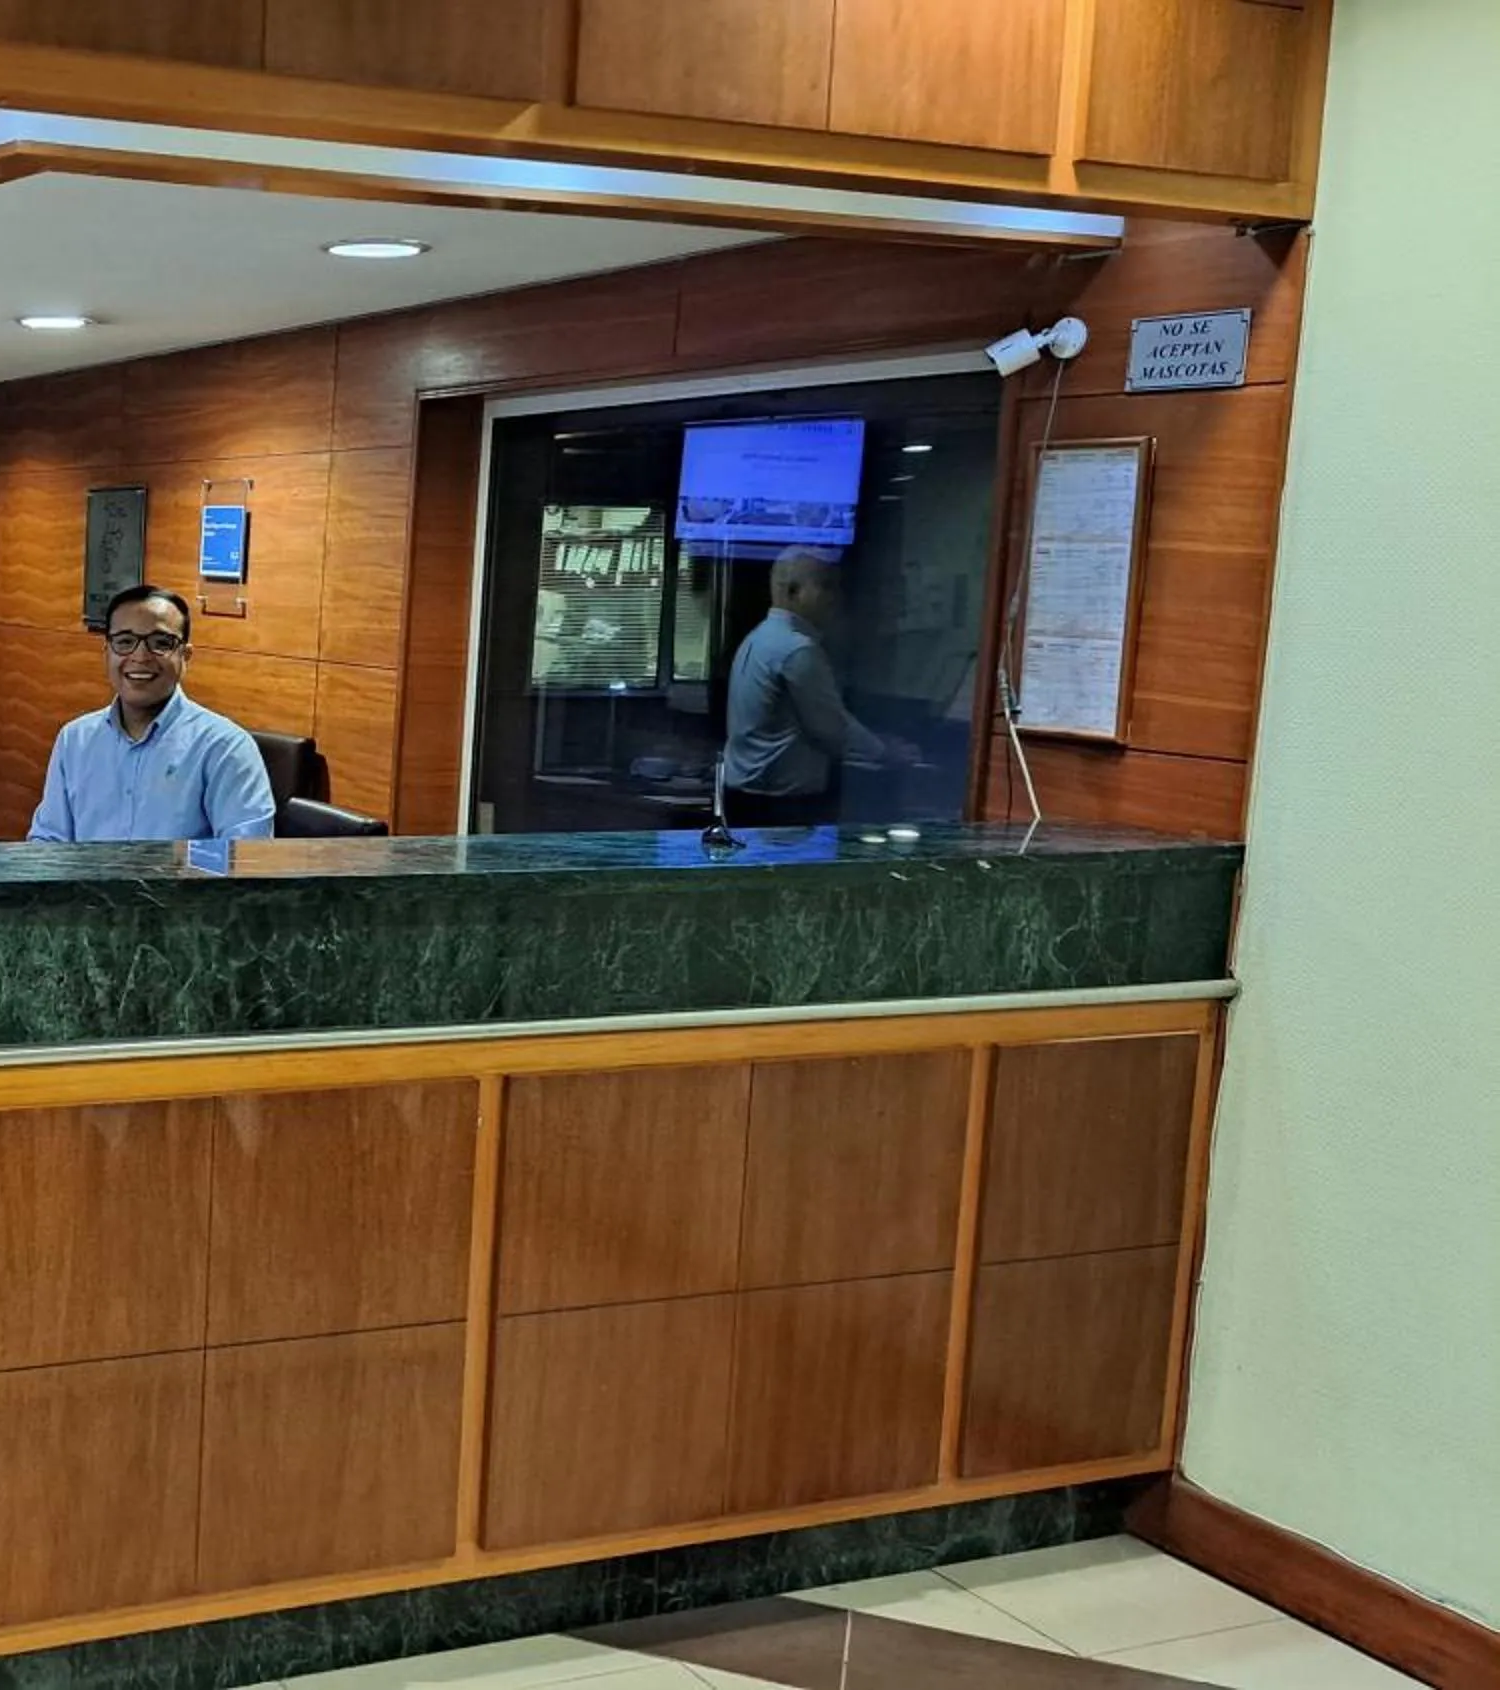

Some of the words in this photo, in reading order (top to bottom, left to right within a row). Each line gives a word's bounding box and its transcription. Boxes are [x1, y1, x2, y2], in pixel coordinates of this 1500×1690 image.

[1161, 322, 1183, 337] NO
[1190, 319, 1213, 335] SE
[1146, 338, 1225, 359] ACEPTAN
[1140, 360, 1229, 381] MASCOTAS
